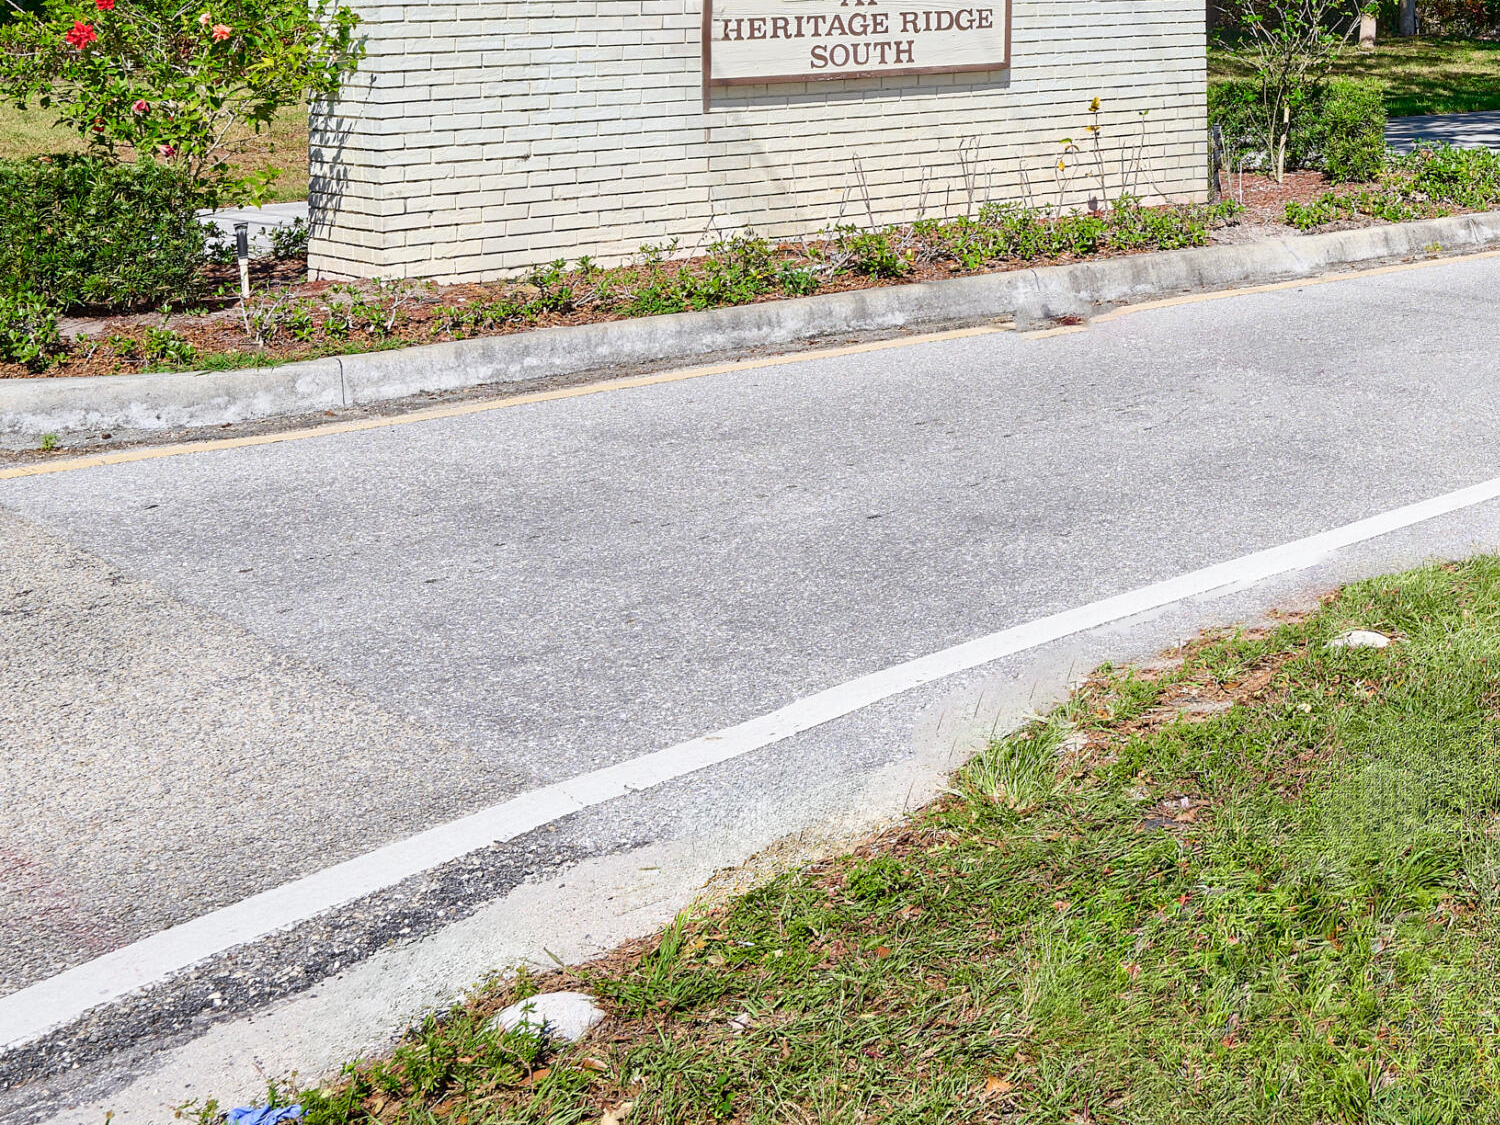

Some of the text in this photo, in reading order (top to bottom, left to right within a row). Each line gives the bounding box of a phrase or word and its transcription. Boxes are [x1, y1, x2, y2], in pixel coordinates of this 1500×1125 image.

[714, 8, 994, 42] HERITAGE RIDGE
[810, 39, 915, 69] SOUTH
